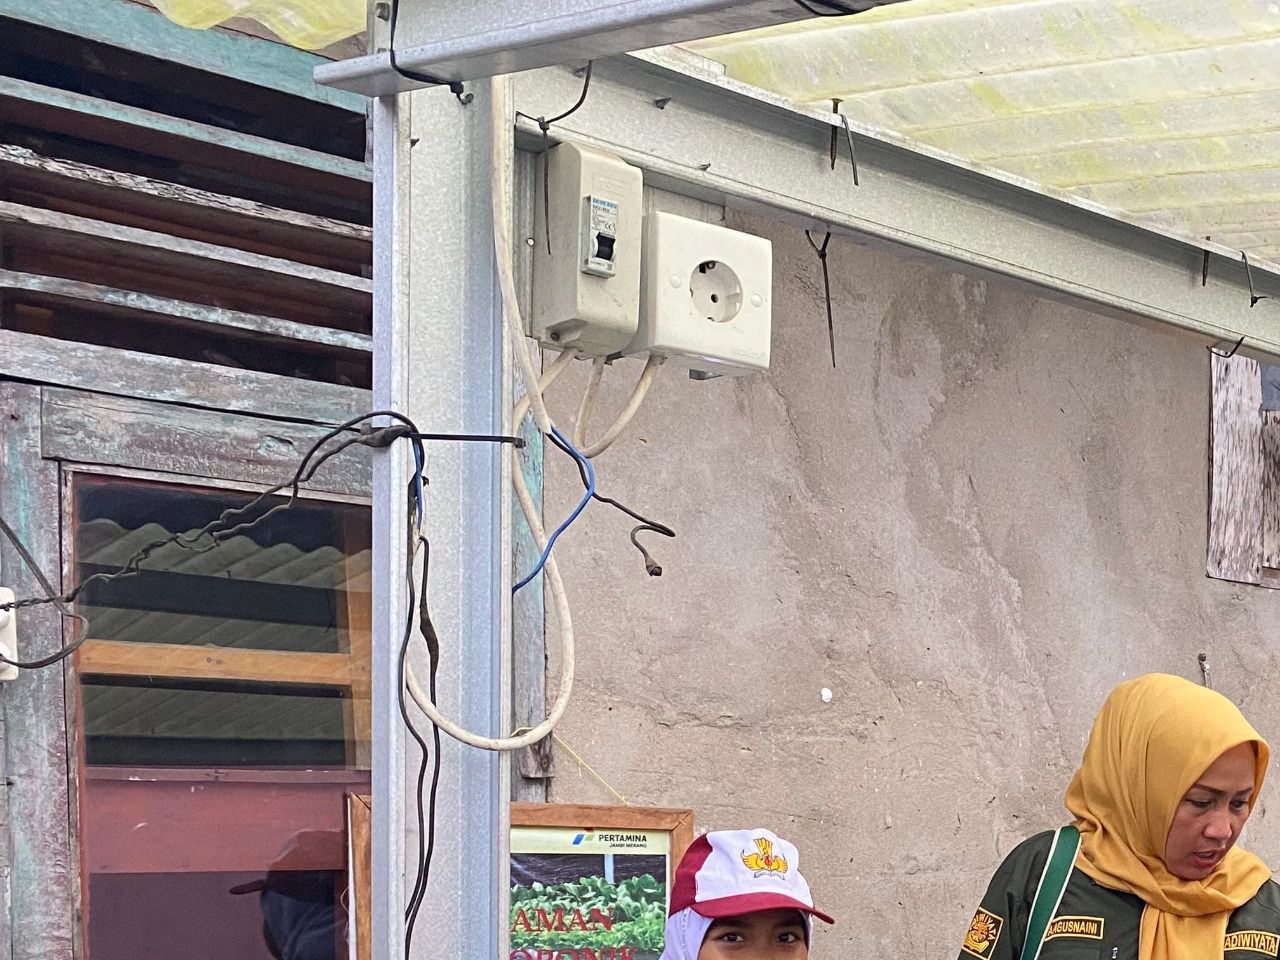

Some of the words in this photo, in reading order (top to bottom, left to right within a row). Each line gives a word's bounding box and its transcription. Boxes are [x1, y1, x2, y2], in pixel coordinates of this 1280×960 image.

[598, 834, 647, 842] PERTAMINA
[510, 907, 616, 933] AMAN
[1224, 933, 1276, 953] ADIWIYATA
